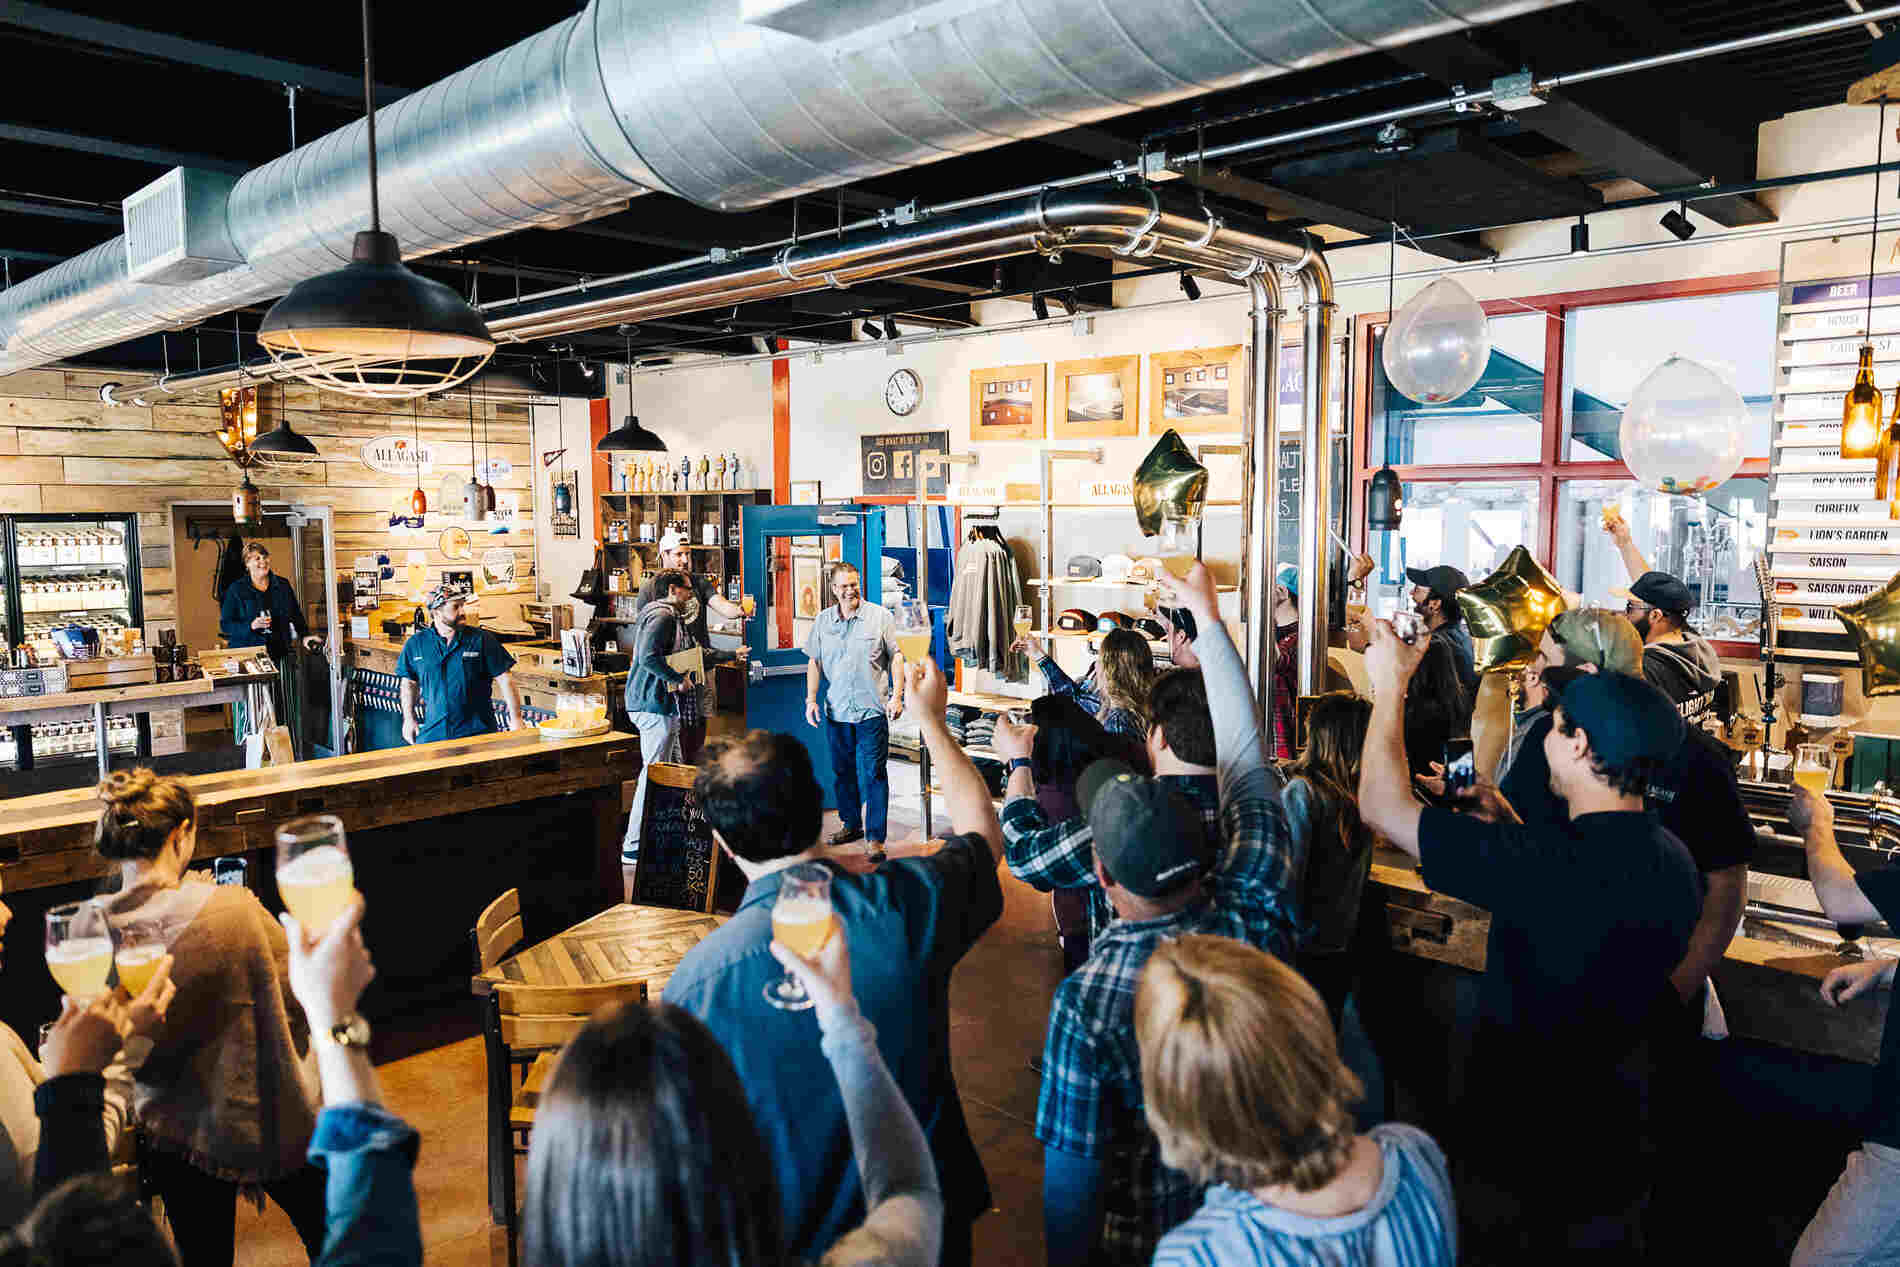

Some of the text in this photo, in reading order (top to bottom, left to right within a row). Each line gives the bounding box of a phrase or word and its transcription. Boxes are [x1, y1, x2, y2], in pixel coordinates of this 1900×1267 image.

[1828, 284, 1857, 297] BEER
[1809, 529, 1889, 541] LION'S GARDEN
[1808, 557, 1847, 568] SAISON
[1808, 582, 1878, 595] SAISON GRAT
